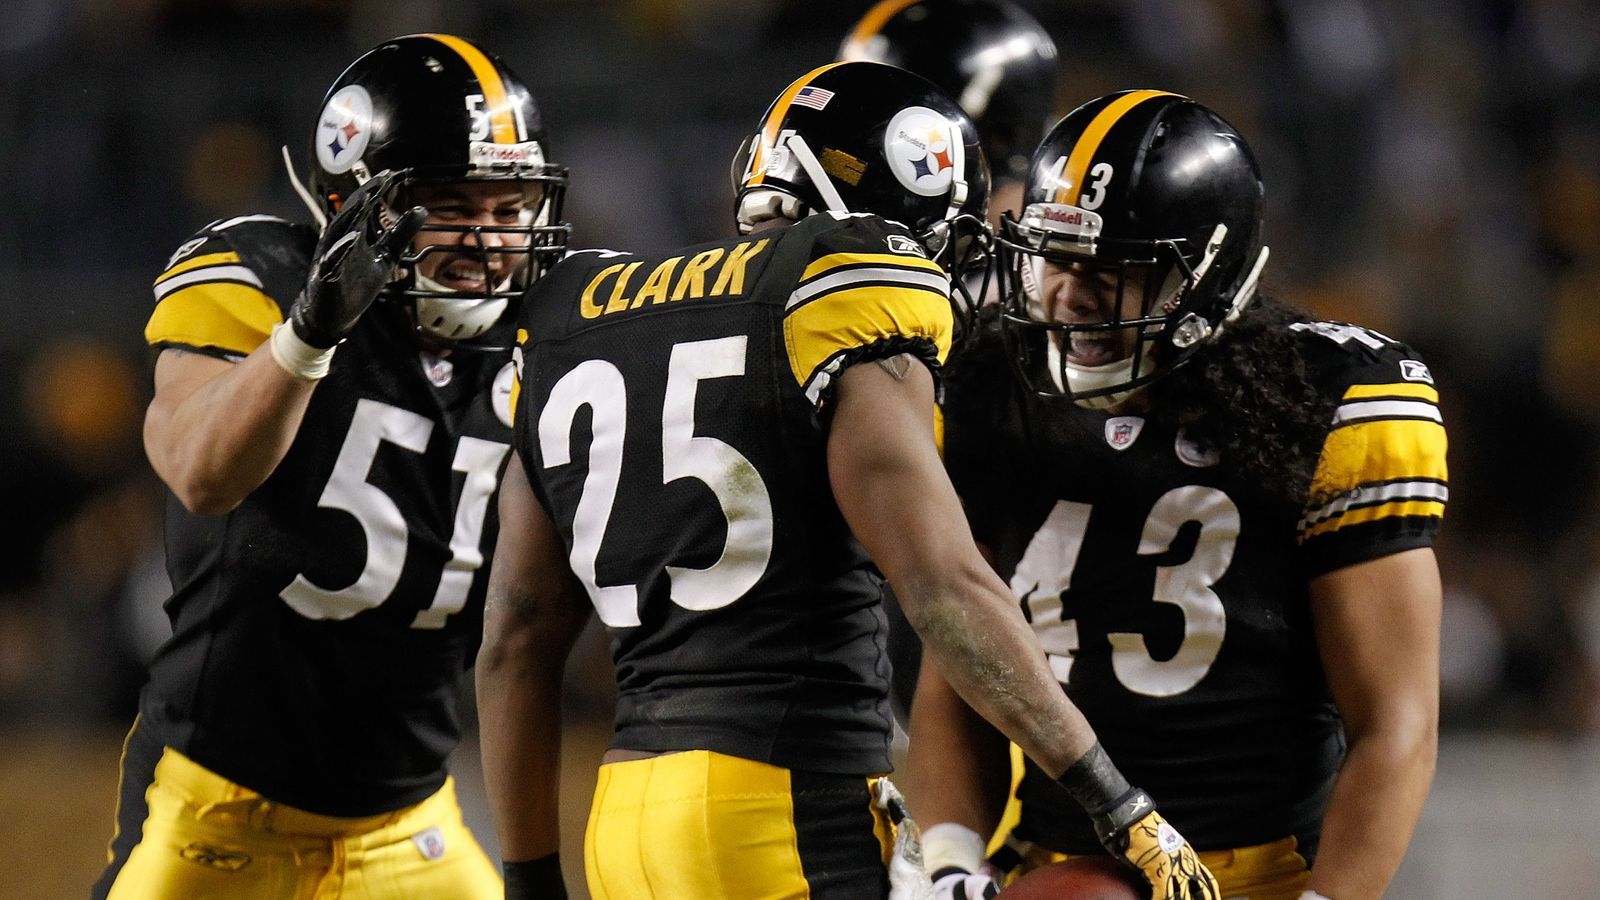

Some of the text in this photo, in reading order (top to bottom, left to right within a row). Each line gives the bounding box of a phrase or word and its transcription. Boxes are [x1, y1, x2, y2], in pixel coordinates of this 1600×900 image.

[580, 237, 770, 319] CLARK
[1040, 155, 1114, 211] 43
[278, 398, 511, 629] 51
[538, 335, 774, 627] 25
[1009, 485, 1241, 697] 43
